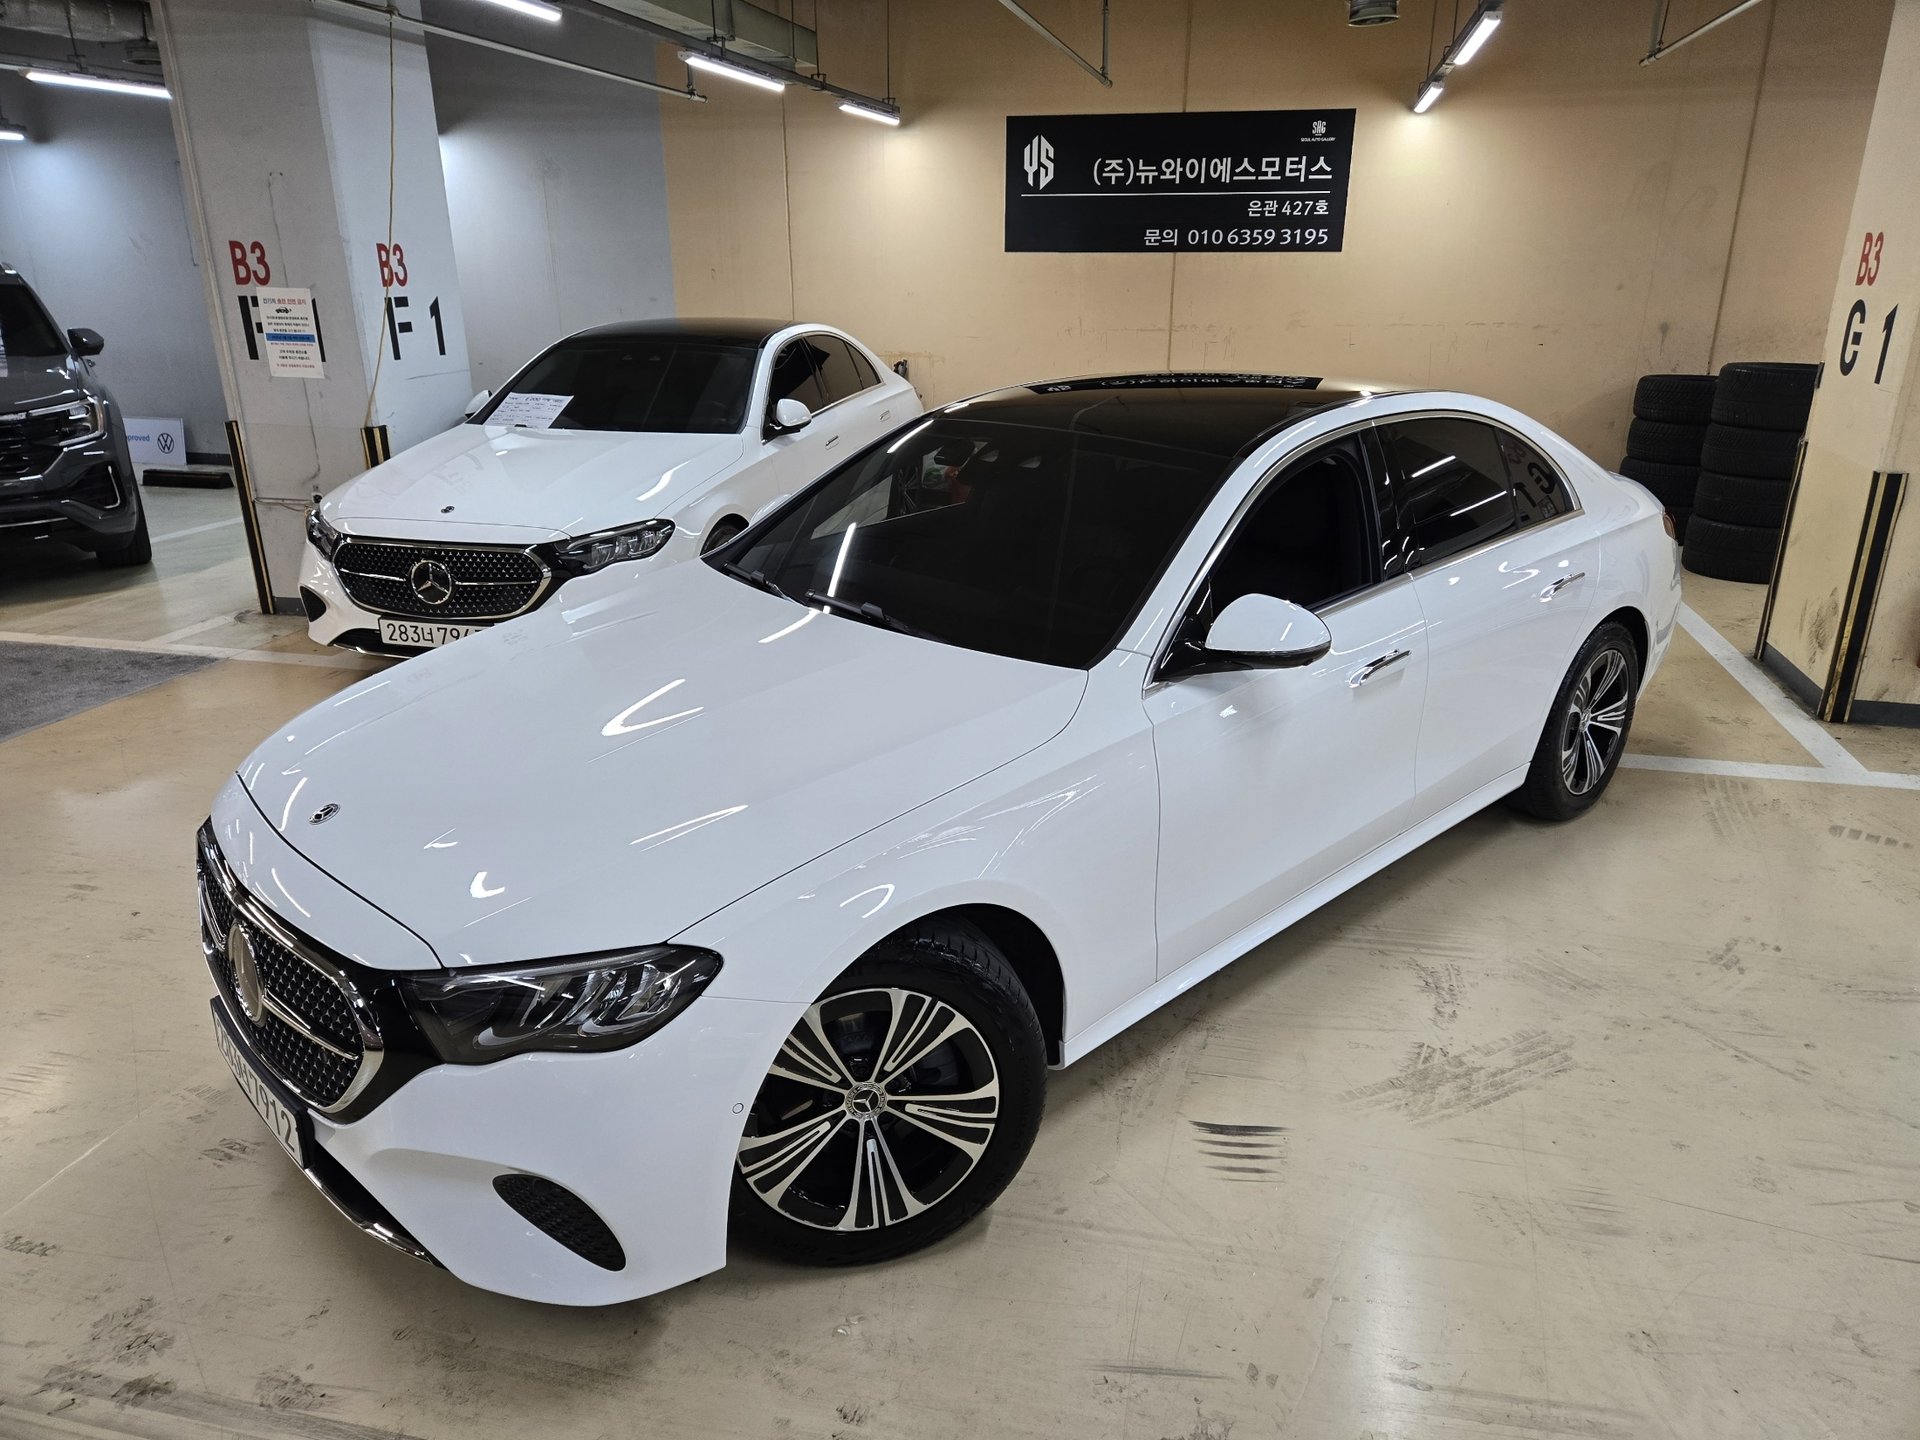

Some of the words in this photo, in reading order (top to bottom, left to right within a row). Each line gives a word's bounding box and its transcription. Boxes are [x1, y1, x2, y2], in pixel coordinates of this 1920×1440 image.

[1093, 155, 1333, 186] (주)뉴와이에스모터스
[1247, 200, 1279, 217] 은관
[1281, 199, 1329, 216] 427호
[1143, 228, 1179, 246] 문의
[1187, 229, 1224, 246] 010
[1227, 229, 1277, 246] 6359
[1279, 228, 1329, 246] 3195
[228, 240, 271, 286] B3
[376, 242, 408, 288] B3
[1855, 232, 1884, 286] B3
[386, 623, 482, 645] 283너79
